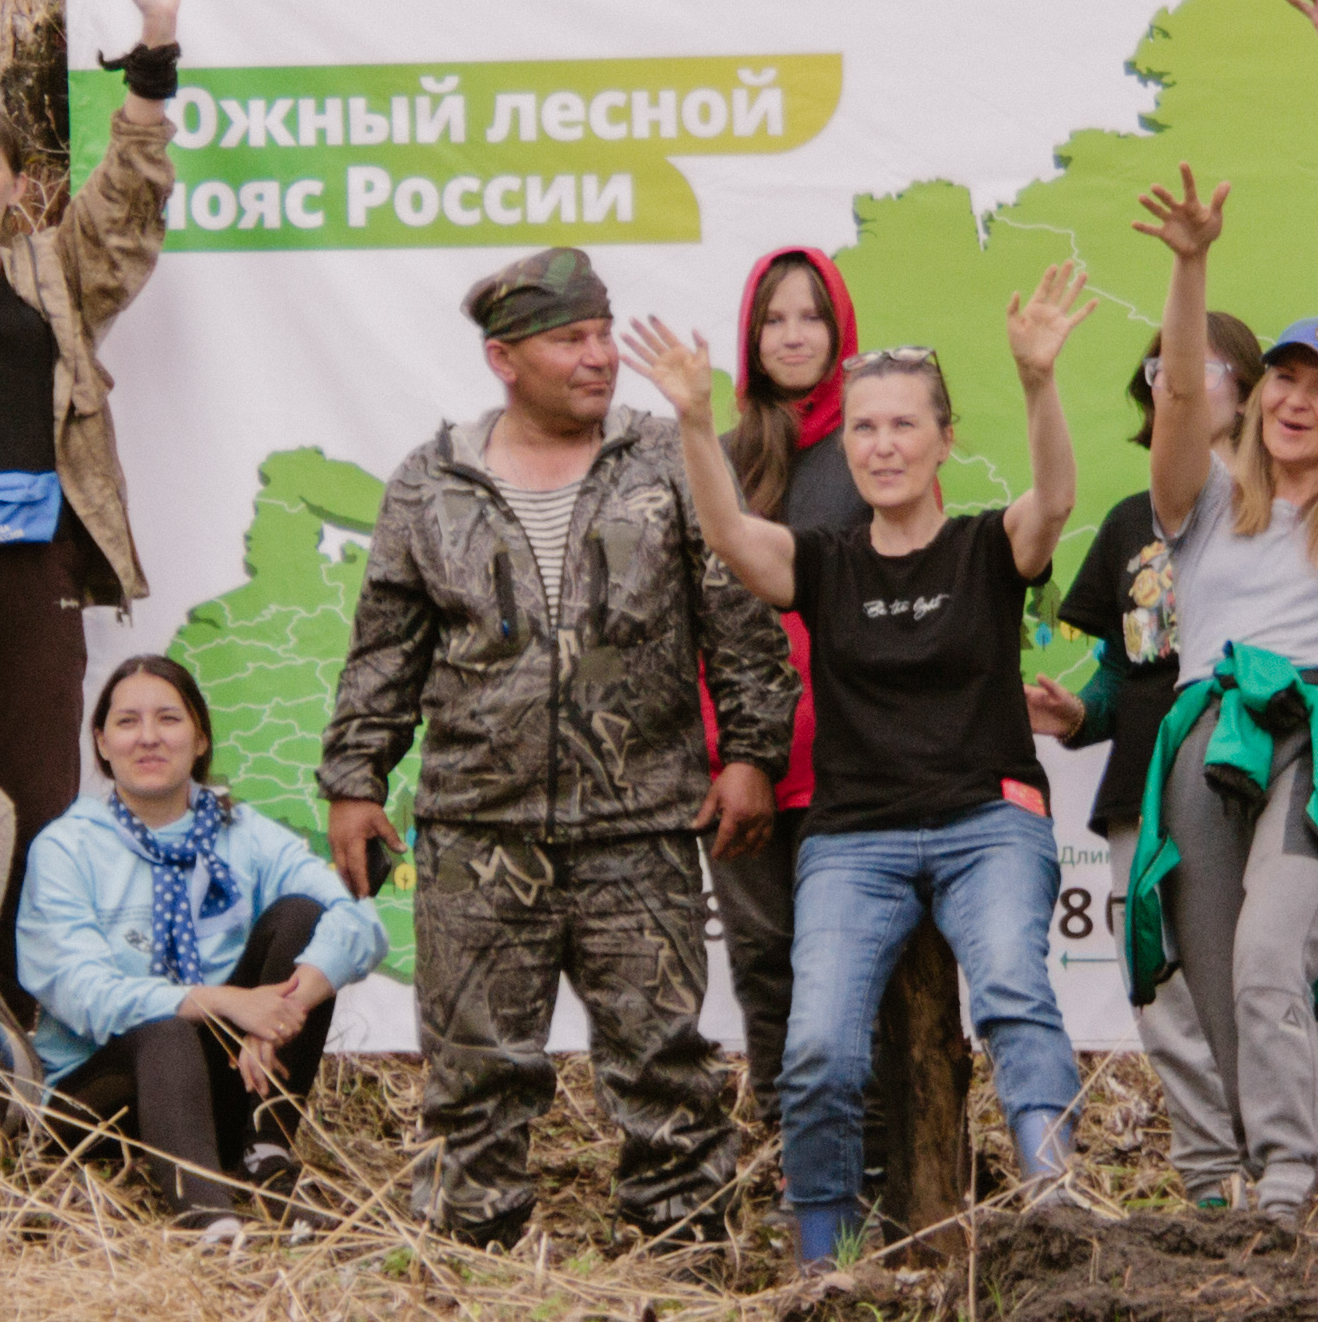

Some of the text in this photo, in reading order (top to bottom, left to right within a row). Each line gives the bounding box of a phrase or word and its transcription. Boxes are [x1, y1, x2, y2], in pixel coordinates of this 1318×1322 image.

[485, 66, 785, 142] лесной
[346, 164, 635, 229] России
[1061, 845, 1111, 868] Дли
